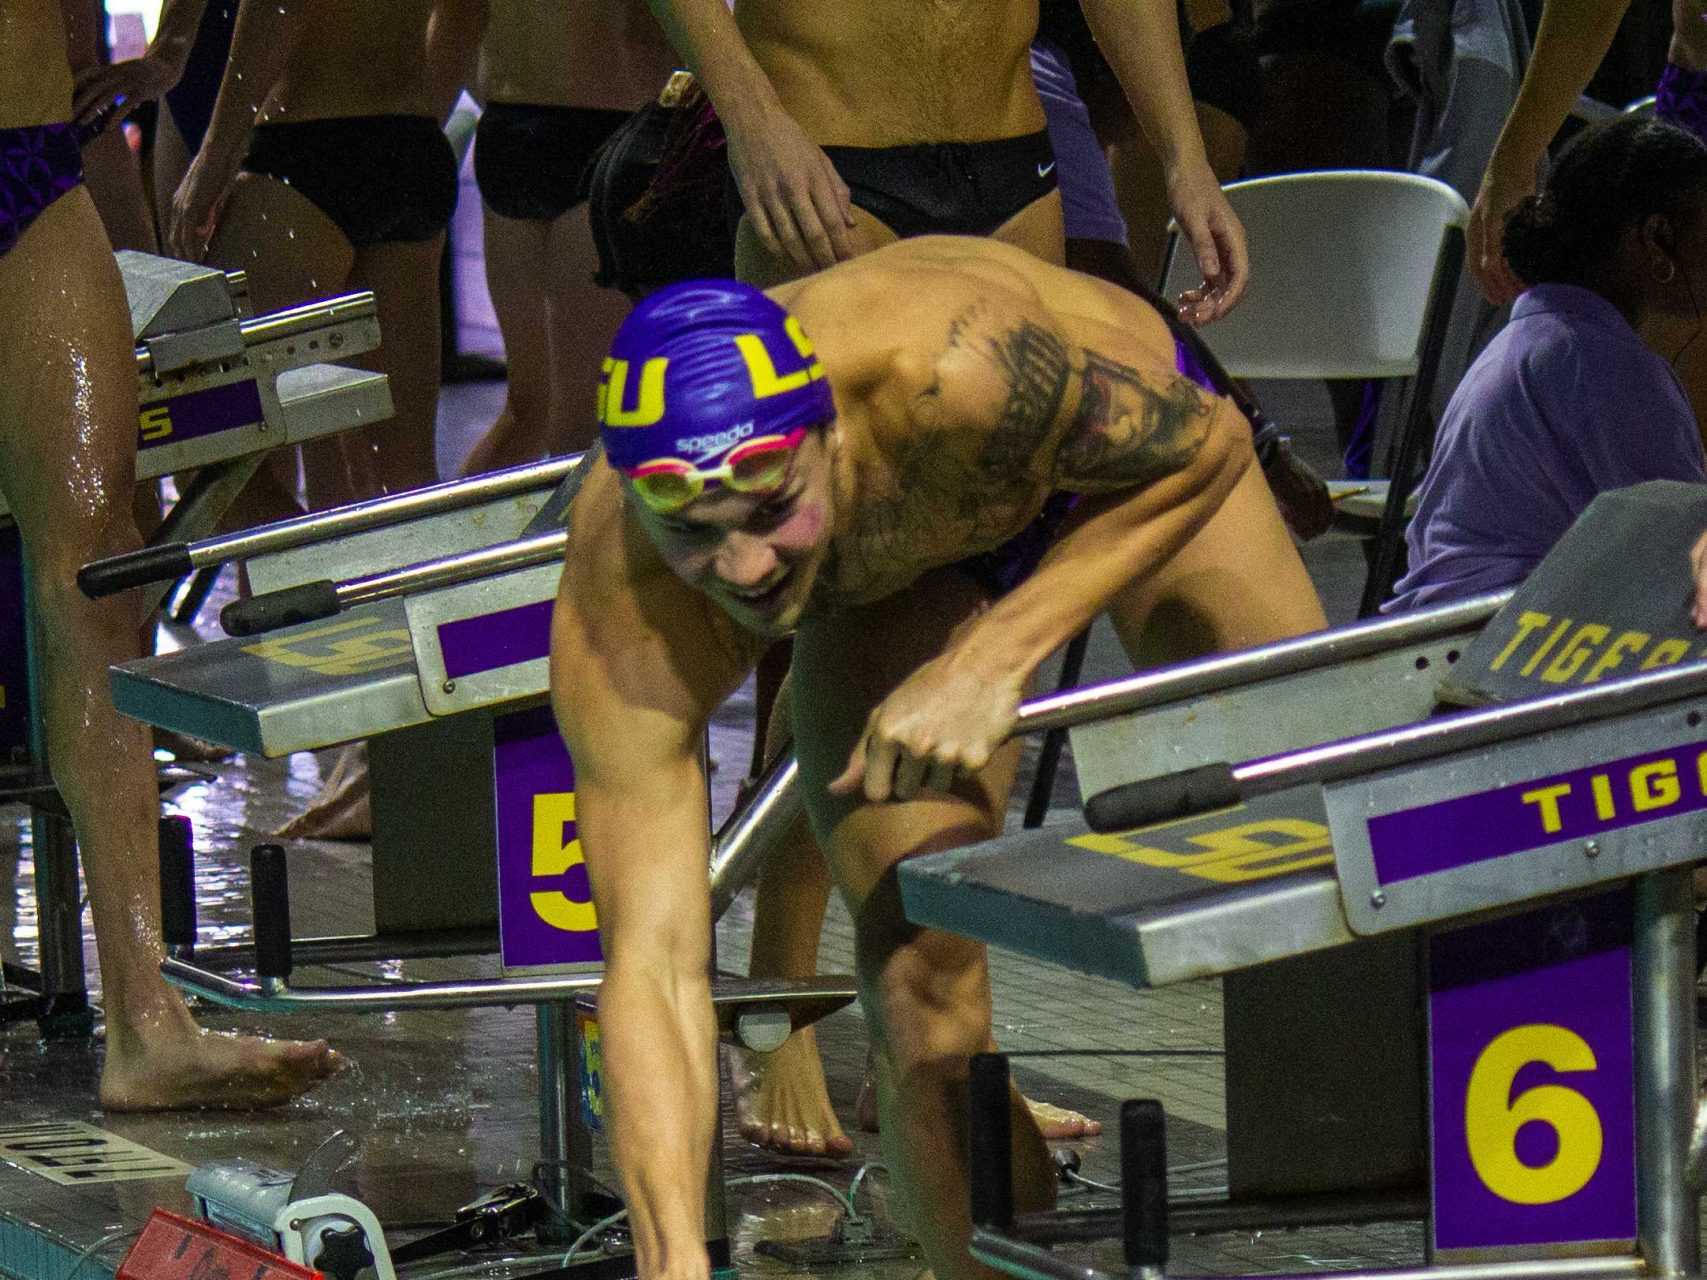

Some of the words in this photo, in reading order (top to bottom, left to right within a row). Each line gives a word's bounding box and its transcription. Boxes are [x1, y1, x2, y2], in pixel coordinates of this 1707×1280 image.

[529, 792, 599, 932] 5
[1521, 751, 1707, 834] TIG
[1465, 1023, 1603, 1205] 6
